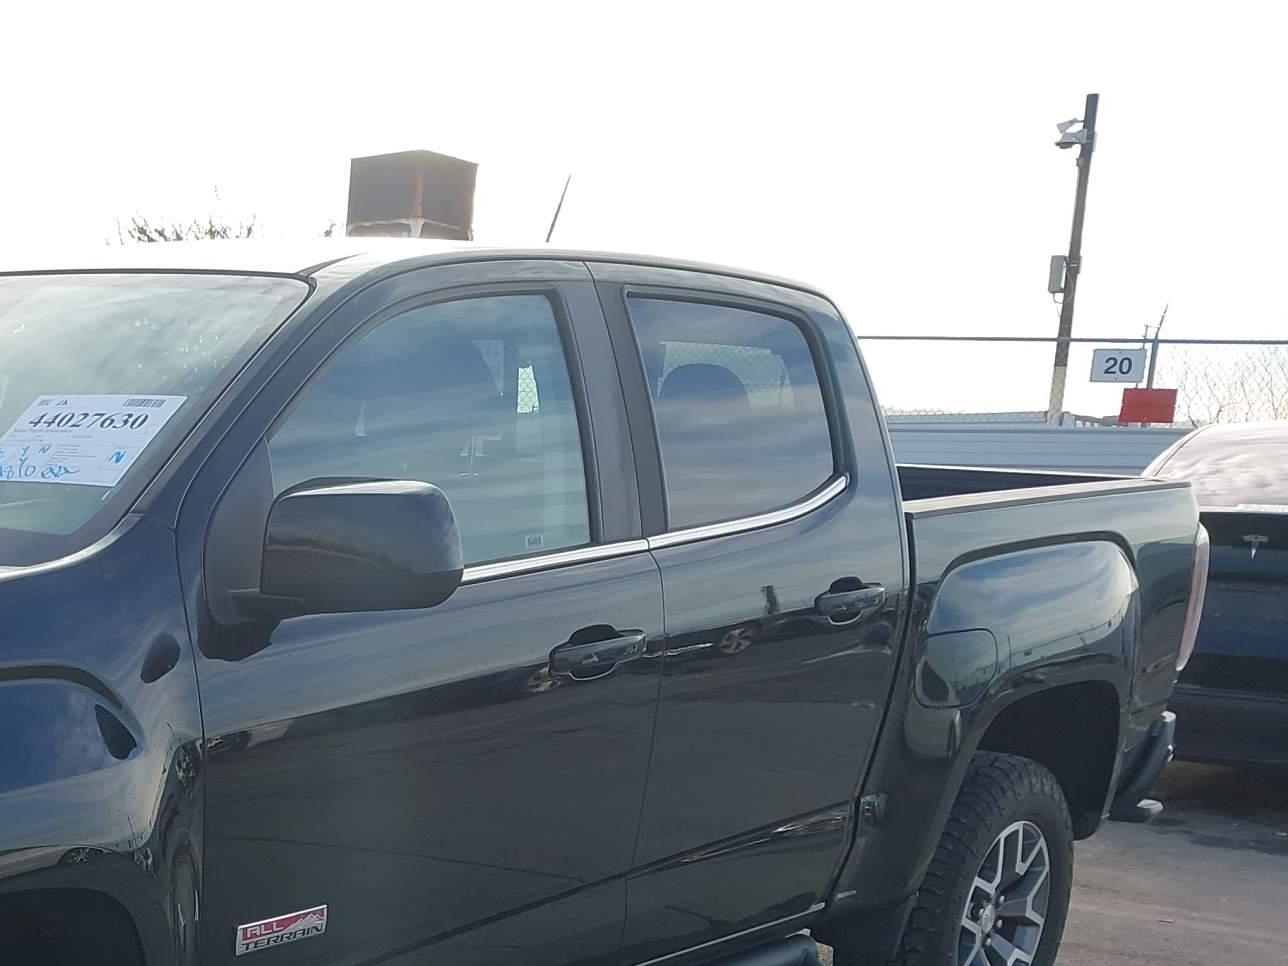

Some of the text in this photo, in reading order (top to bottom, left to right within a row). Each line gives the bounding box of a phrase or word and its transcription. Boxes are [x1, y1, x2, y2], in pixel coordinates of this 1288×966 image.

[1103, 356, 1133, 375] 20
[27, 412, 150, 430] 44027630
[242, 923, 324, 951] TERRAIN
[247, 922, 285, 938] ALL
